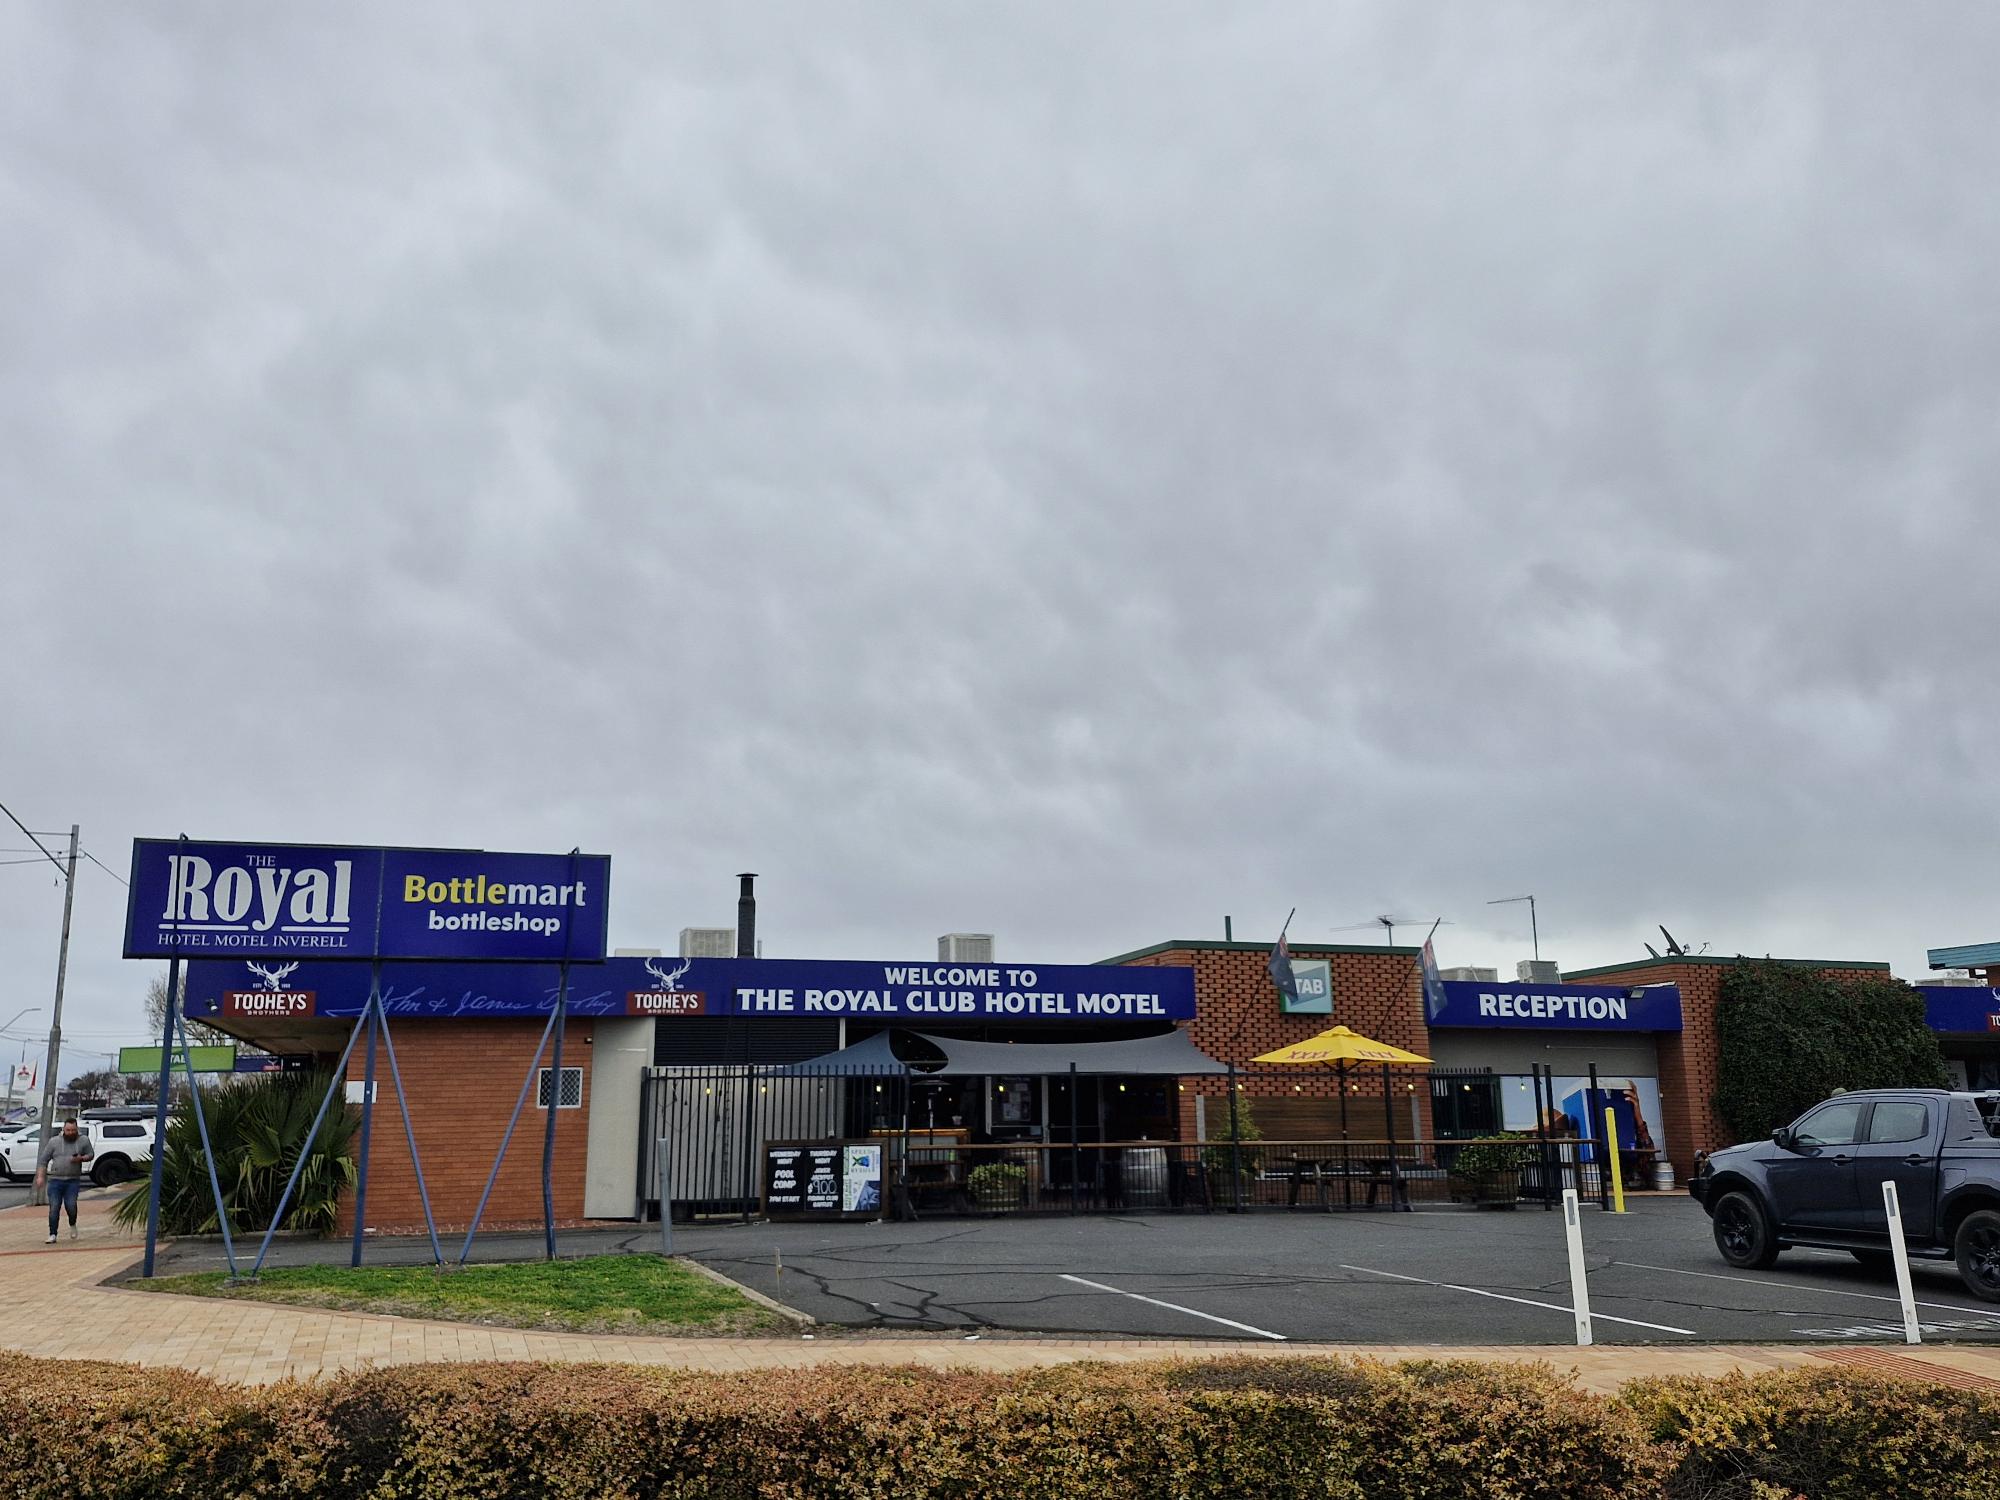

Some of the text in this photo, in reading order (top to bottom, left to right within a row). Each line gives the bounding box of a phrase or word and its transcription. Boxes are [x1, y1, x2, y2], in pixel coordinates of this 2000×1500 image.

[246, 855, 276, 867] THE
[162, 855, 352, 931] Royal
[404, 875, 587, 907] Bottlemart
[428, 910, 561, 937] bottleshop
[158, 933, 348, 948] HOTEL MOTEL INVERELL
[884, 967, 1037, 988] WELCOME TO
[1296, 978, 1324, 995] TAB
[232, 993, 307, 1010] TOOHEYS
[634, 993, 699, 1009] TOOHEYS
[736, 988, 1166, 1015] THE ROYAL CLUB HOTEL MOTEL
[1479, 993, 1627, 1020] RECEPTION
[773, 1180, 797, 1189] COMP
